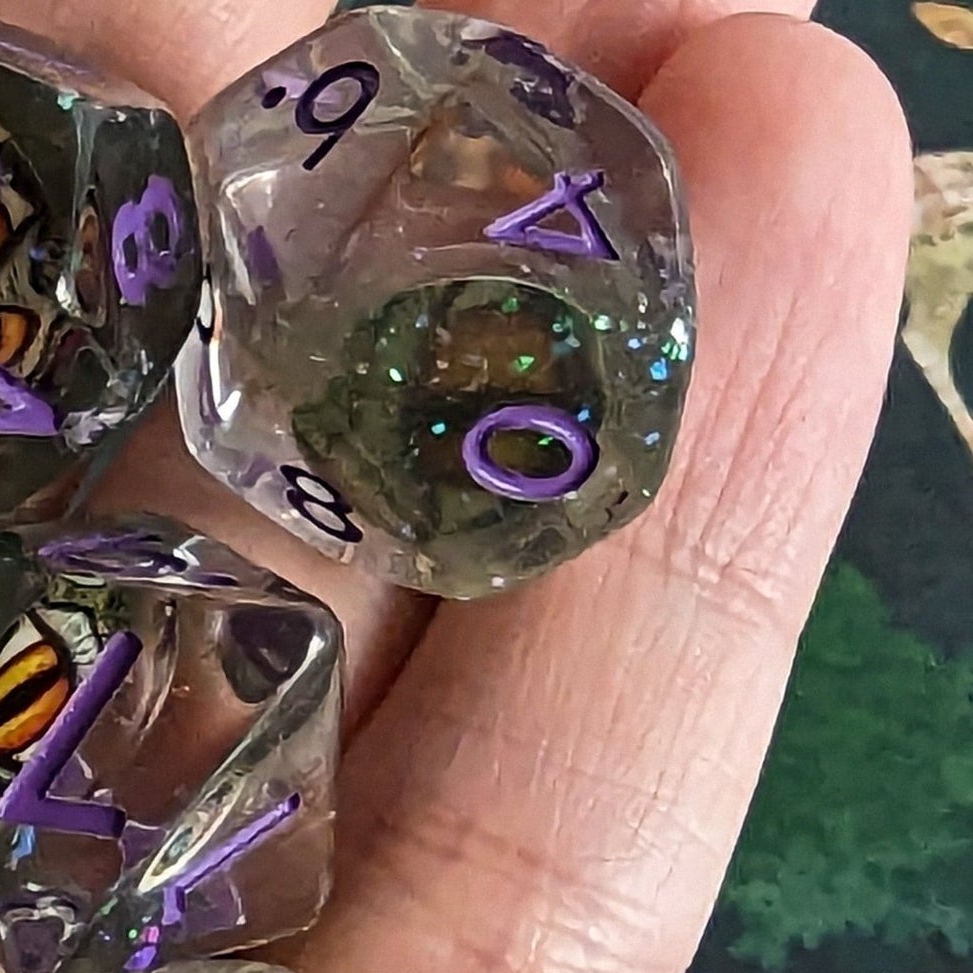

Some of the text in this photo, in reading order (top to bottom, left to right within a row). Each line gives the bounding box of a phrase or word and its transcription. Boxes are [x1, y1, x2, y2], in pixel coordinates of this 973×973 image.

[483, 169, 621, 261] 4
[461, 404, 600, 501] 0
[279, 464, 364, 544] 8
